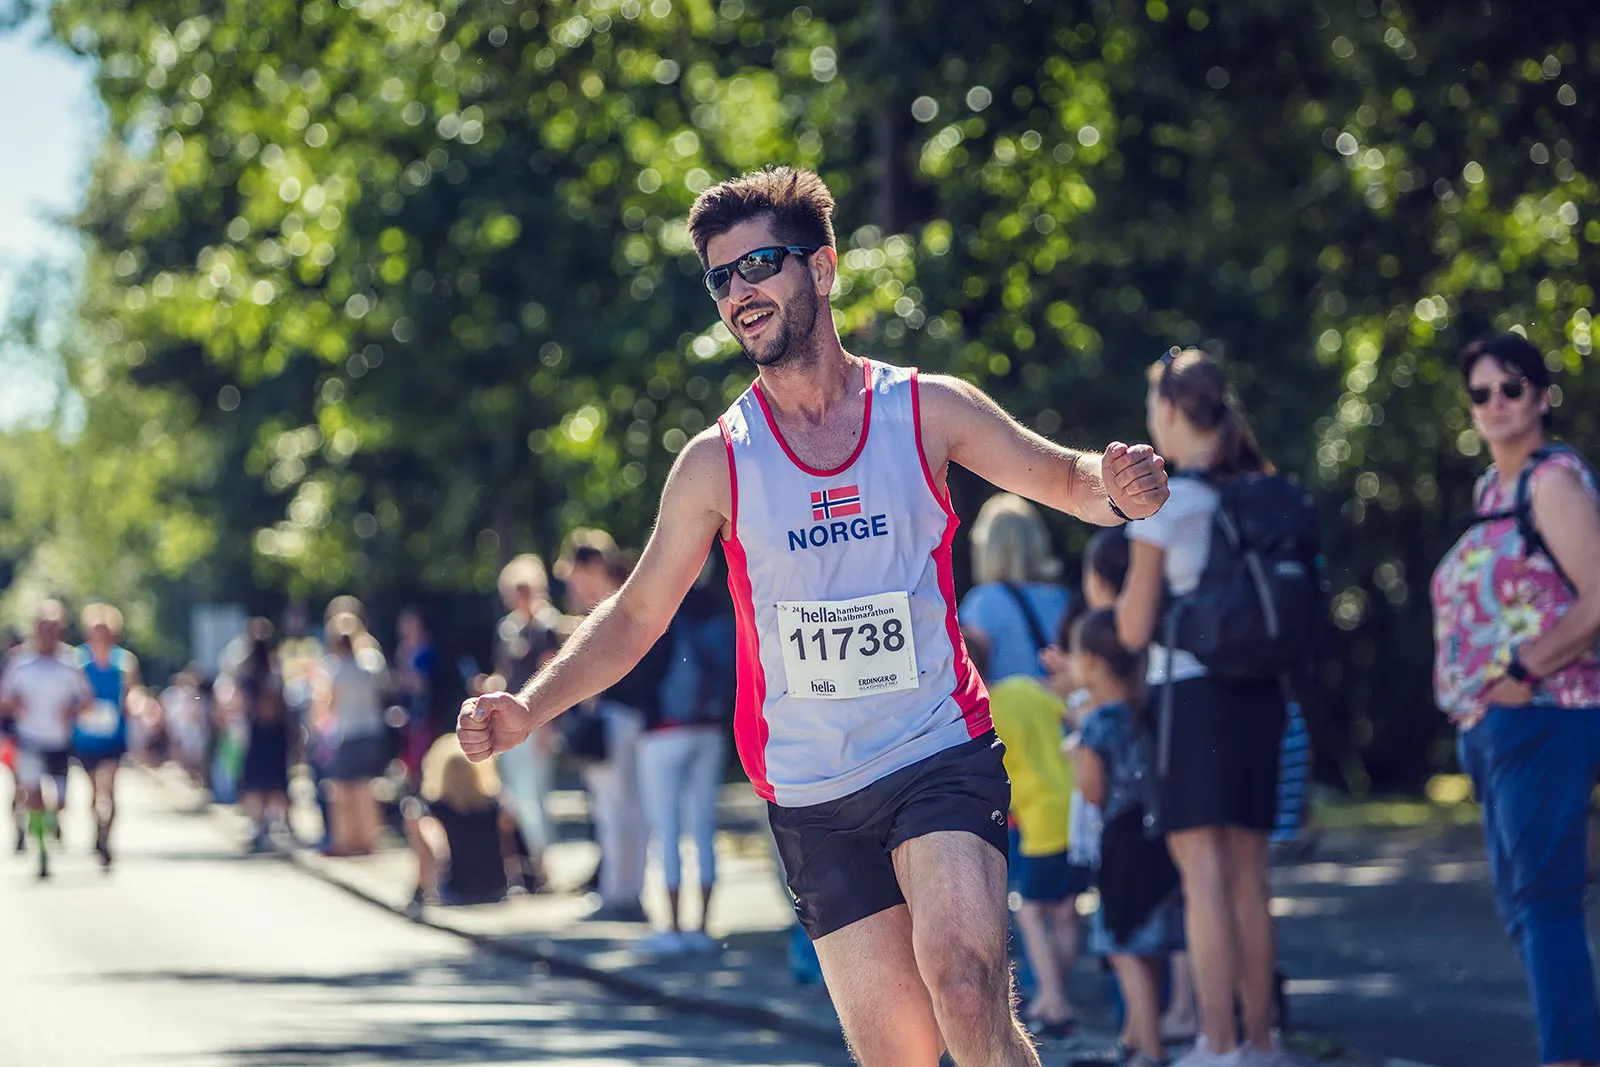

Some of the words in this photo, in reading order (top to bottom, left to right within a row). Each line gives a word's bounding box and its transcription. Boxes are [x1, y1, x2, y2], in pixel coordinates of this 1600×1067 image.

[788, 514, 888, 551] NORGE
[801, 607, 837, 623] hella
[836, 604, 874, 615] hamburg
[837, 607, 895, 622] halbmarathon
[790, 619, 905, 660] 11738
[811, 681, 836, 692] hella
[858, 675, 890, 686] ERDINGER
